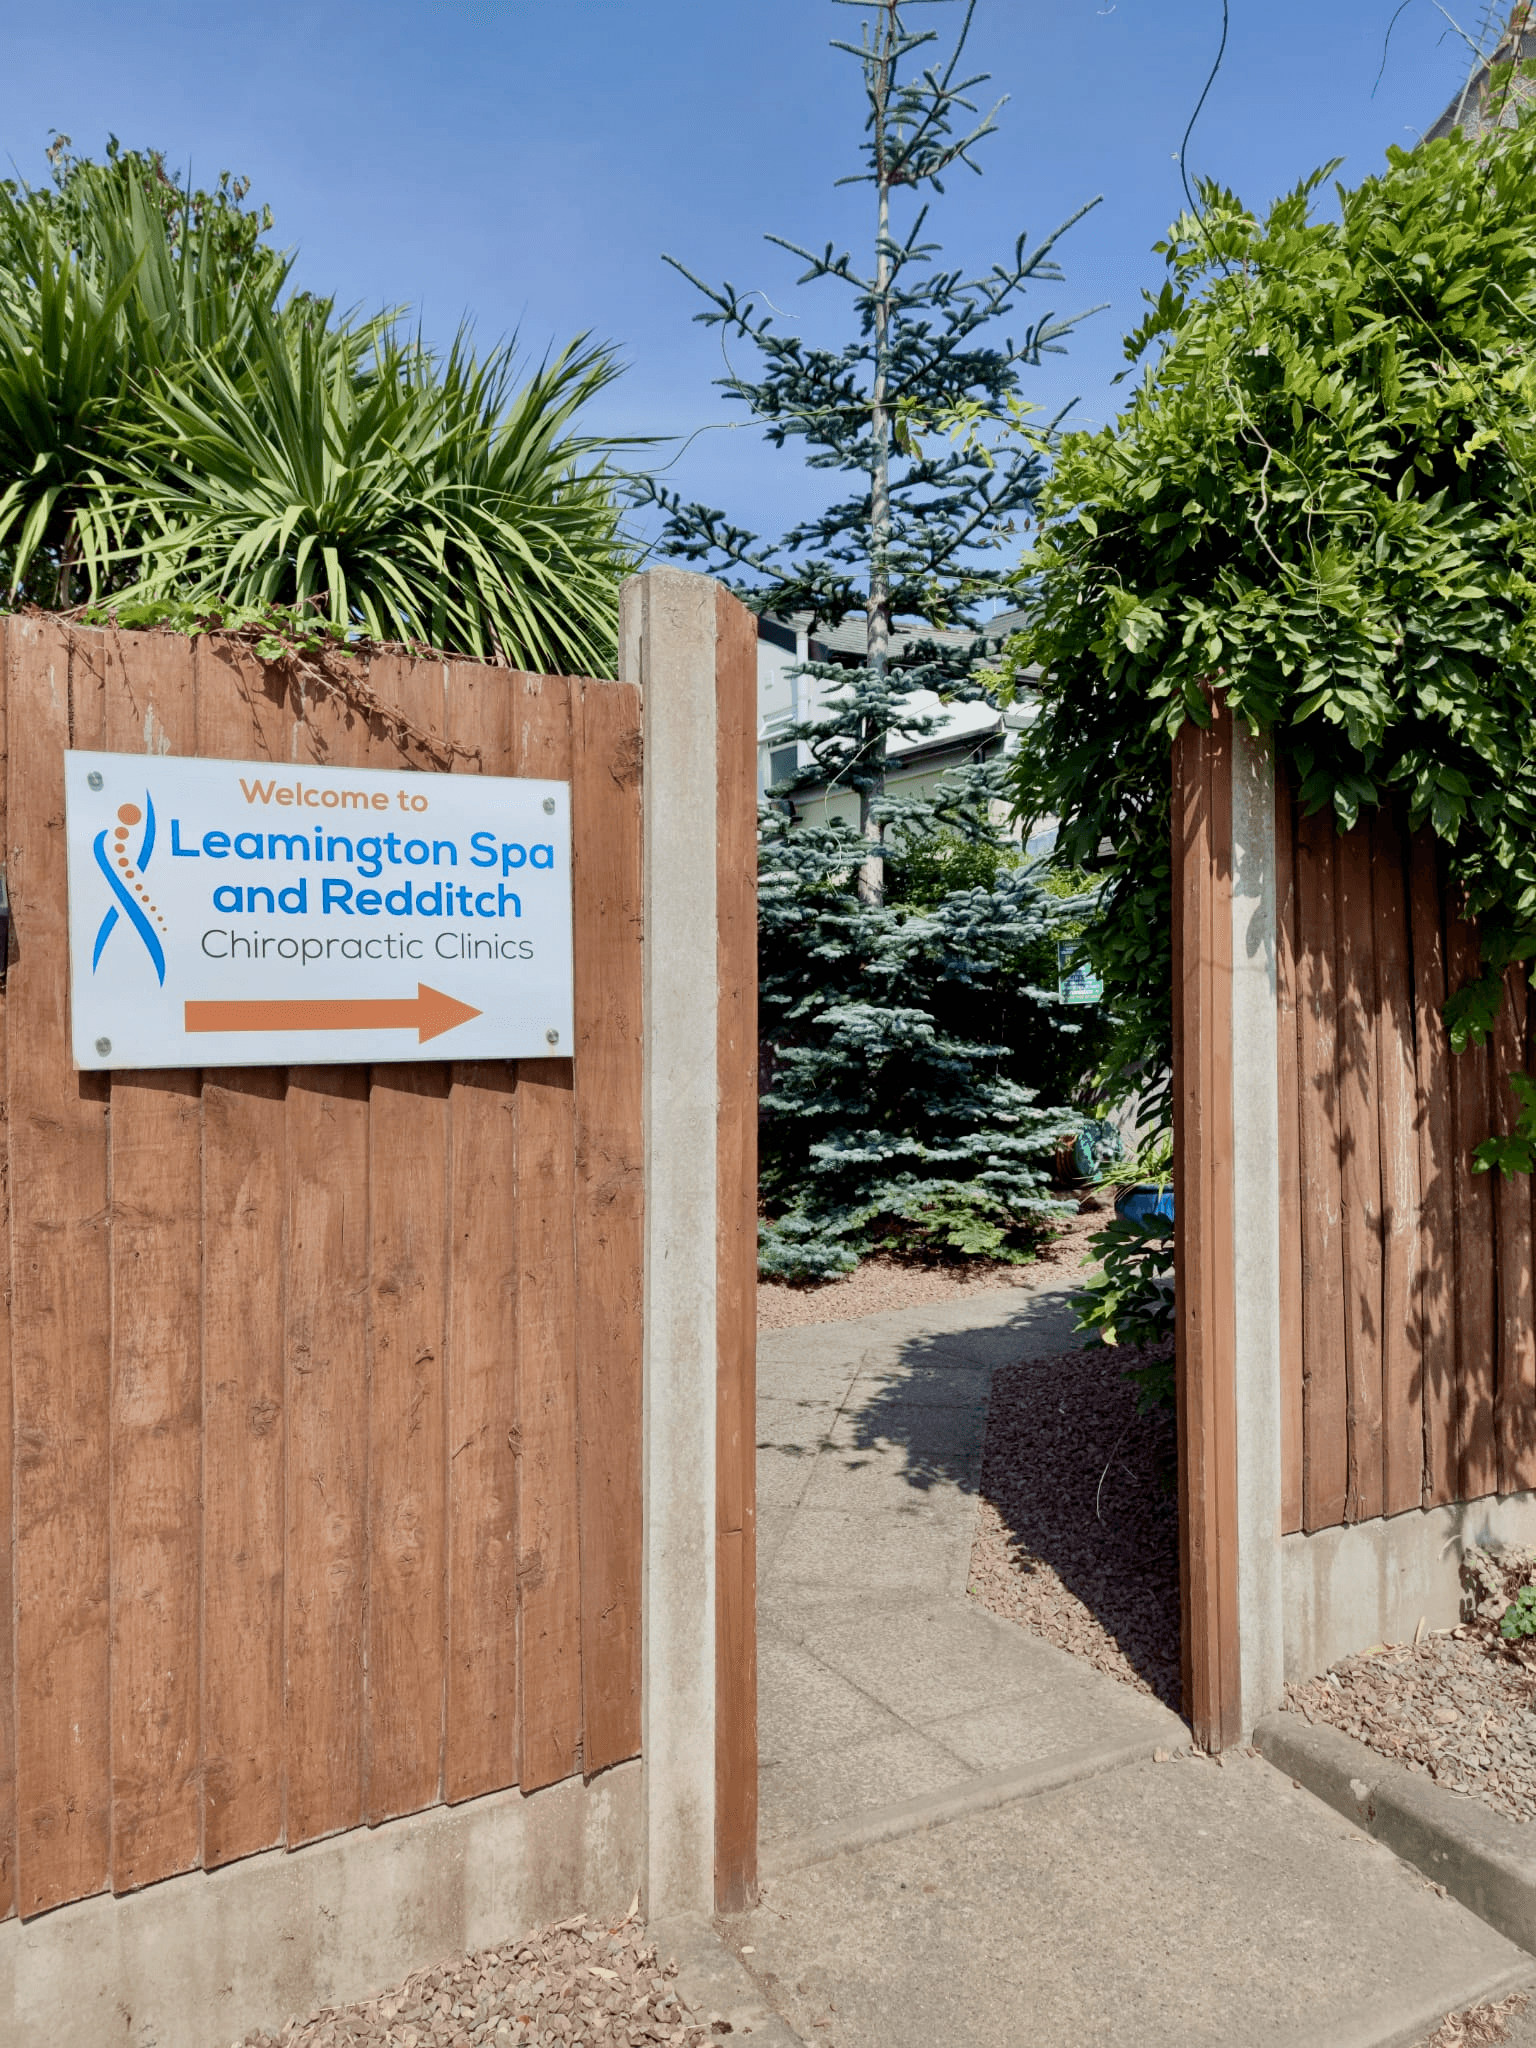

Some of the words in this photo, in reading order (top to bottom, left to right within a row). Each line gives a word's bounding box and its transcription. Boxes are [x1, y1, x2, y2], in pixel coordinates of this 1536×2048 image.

[239, 778, 390, 811] Welcome
[396, 790, 429, 813] to
[170, 818, 458, 879] Leamington
[469, 831, 555, 878] Spa
[212, 877, 308, 915] and
[321, 877, 522, 918] Redditch
[201, 929, 424, 967] Chiropractic
[434, 932, 534, 960] Clinics
